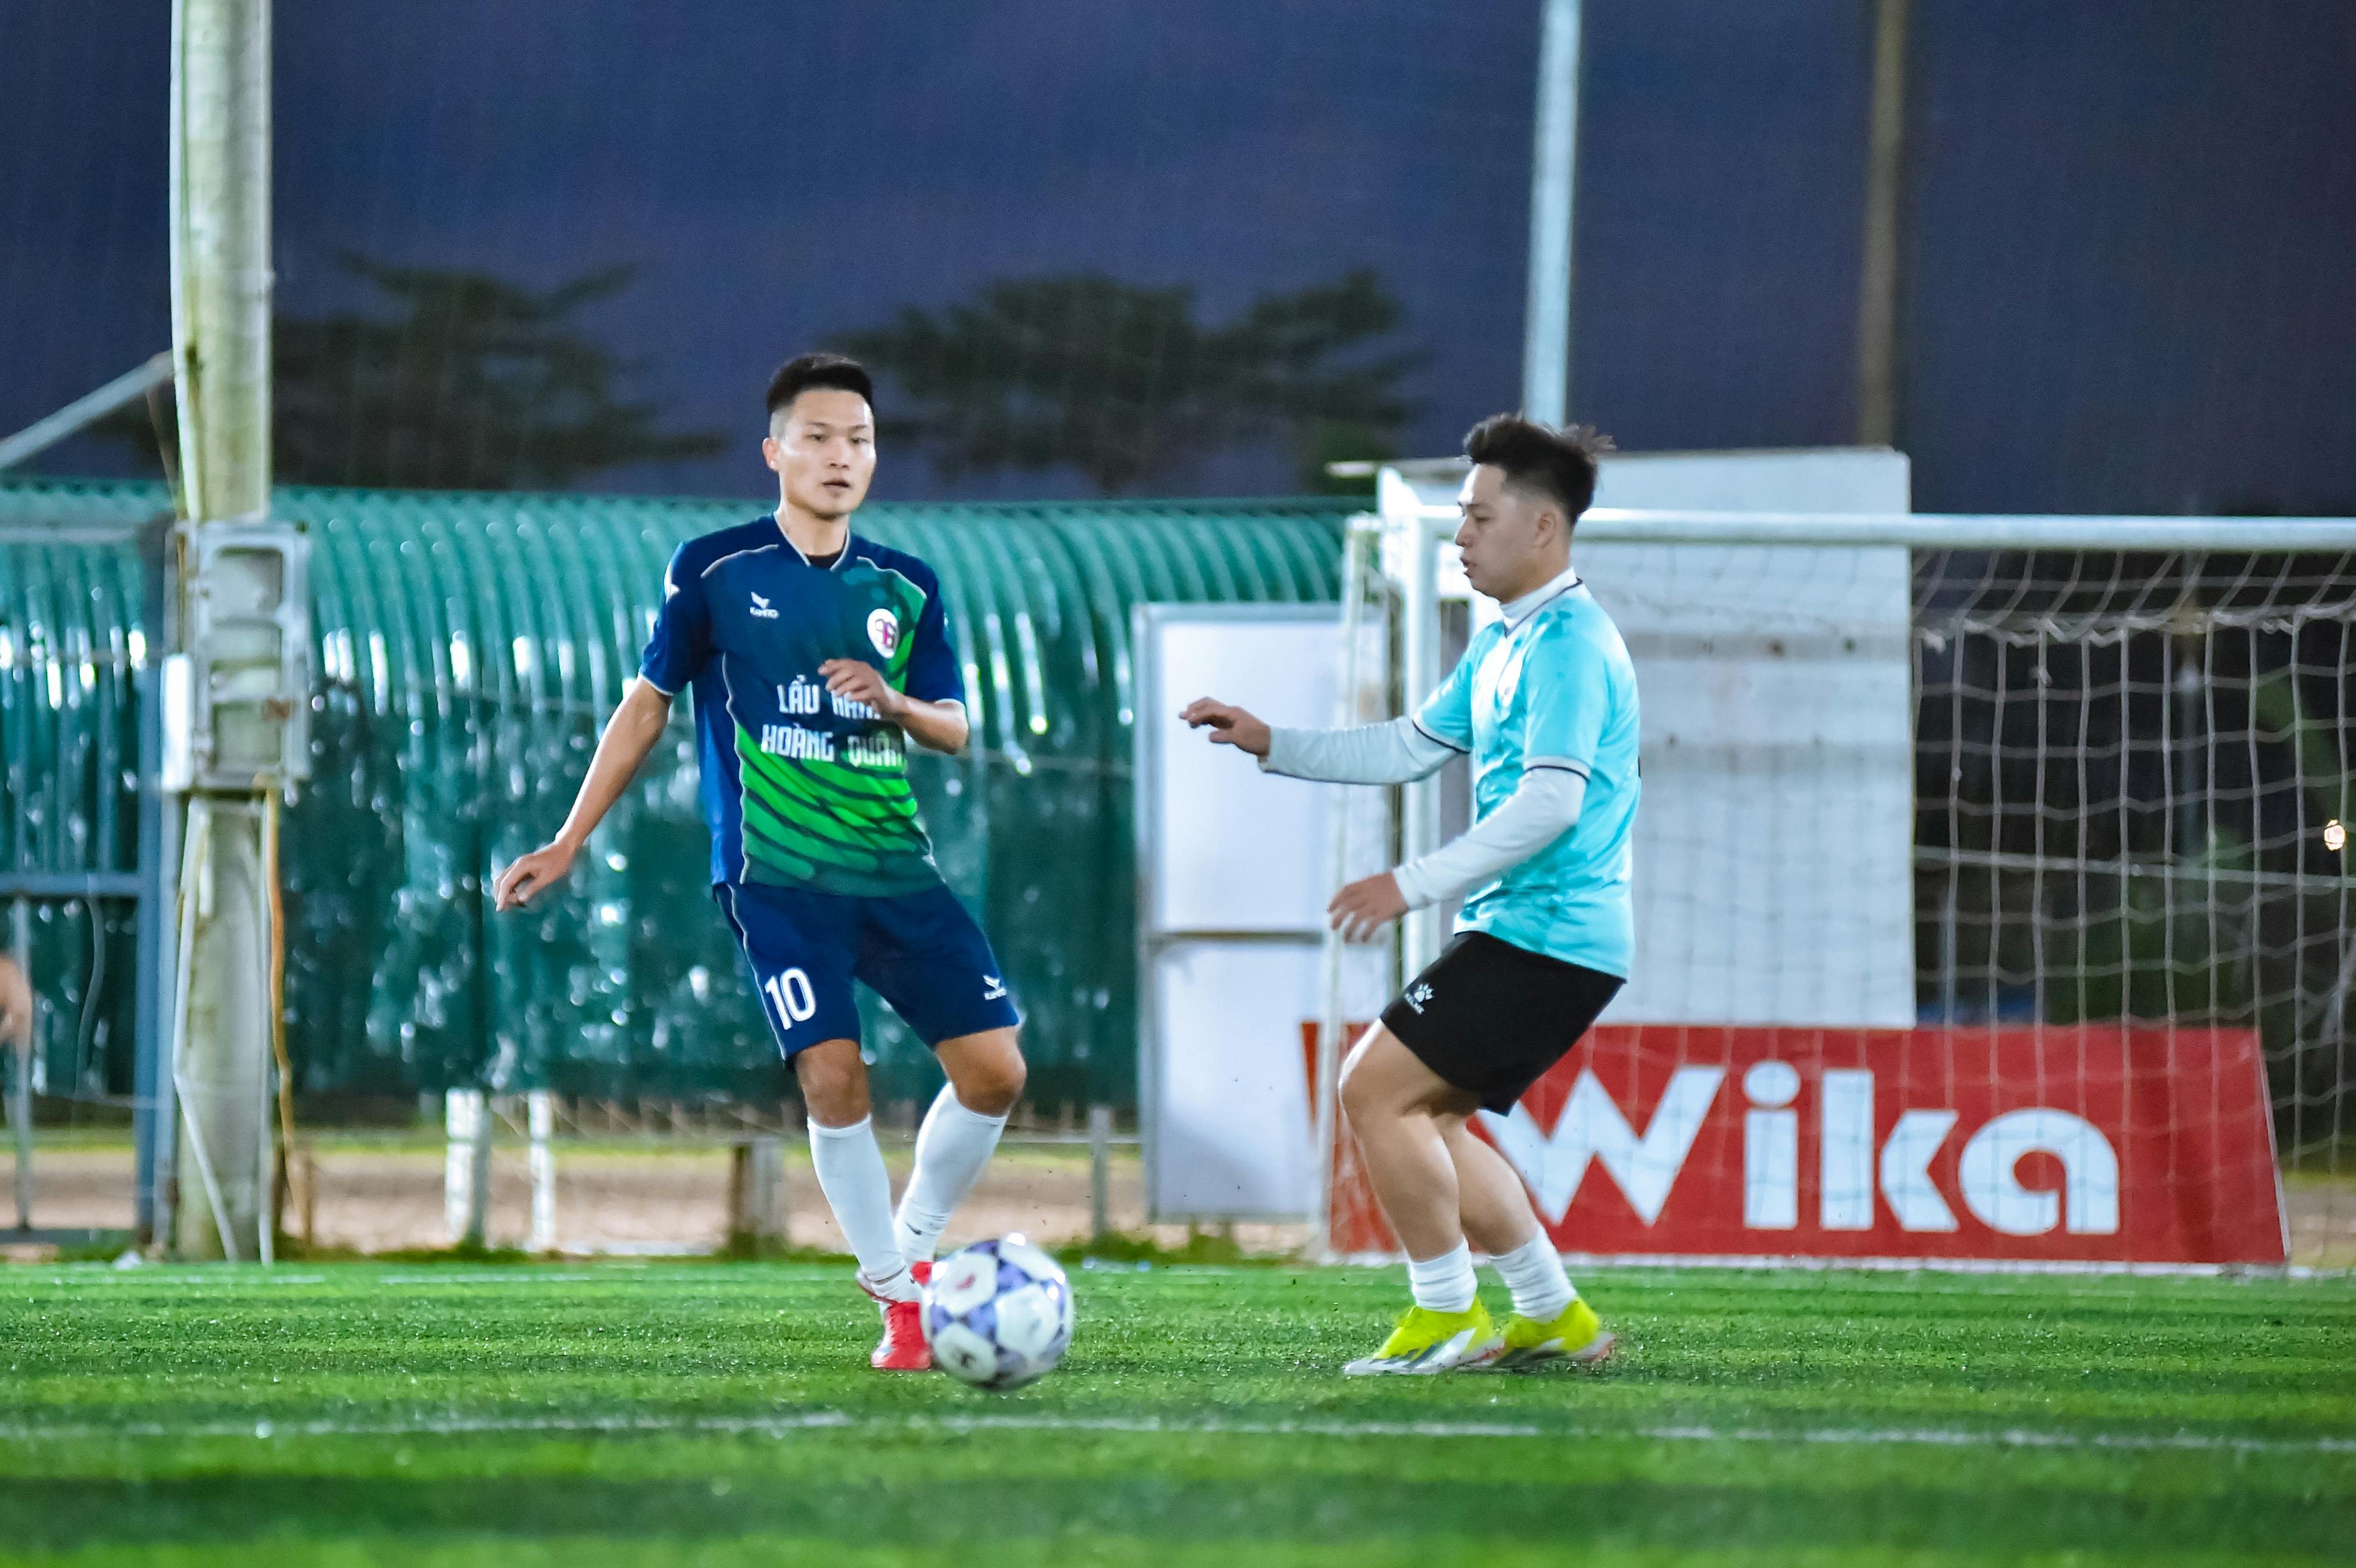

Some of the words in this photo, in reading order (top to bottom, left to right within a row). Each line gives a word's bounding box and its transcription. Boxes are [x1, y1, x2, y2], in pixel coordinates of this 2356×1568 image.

[761, 723, 834, 762] HOÀNG
[765, 967, 816, 1030] 10
[1475, 1060, 2120, 1236] Wika
